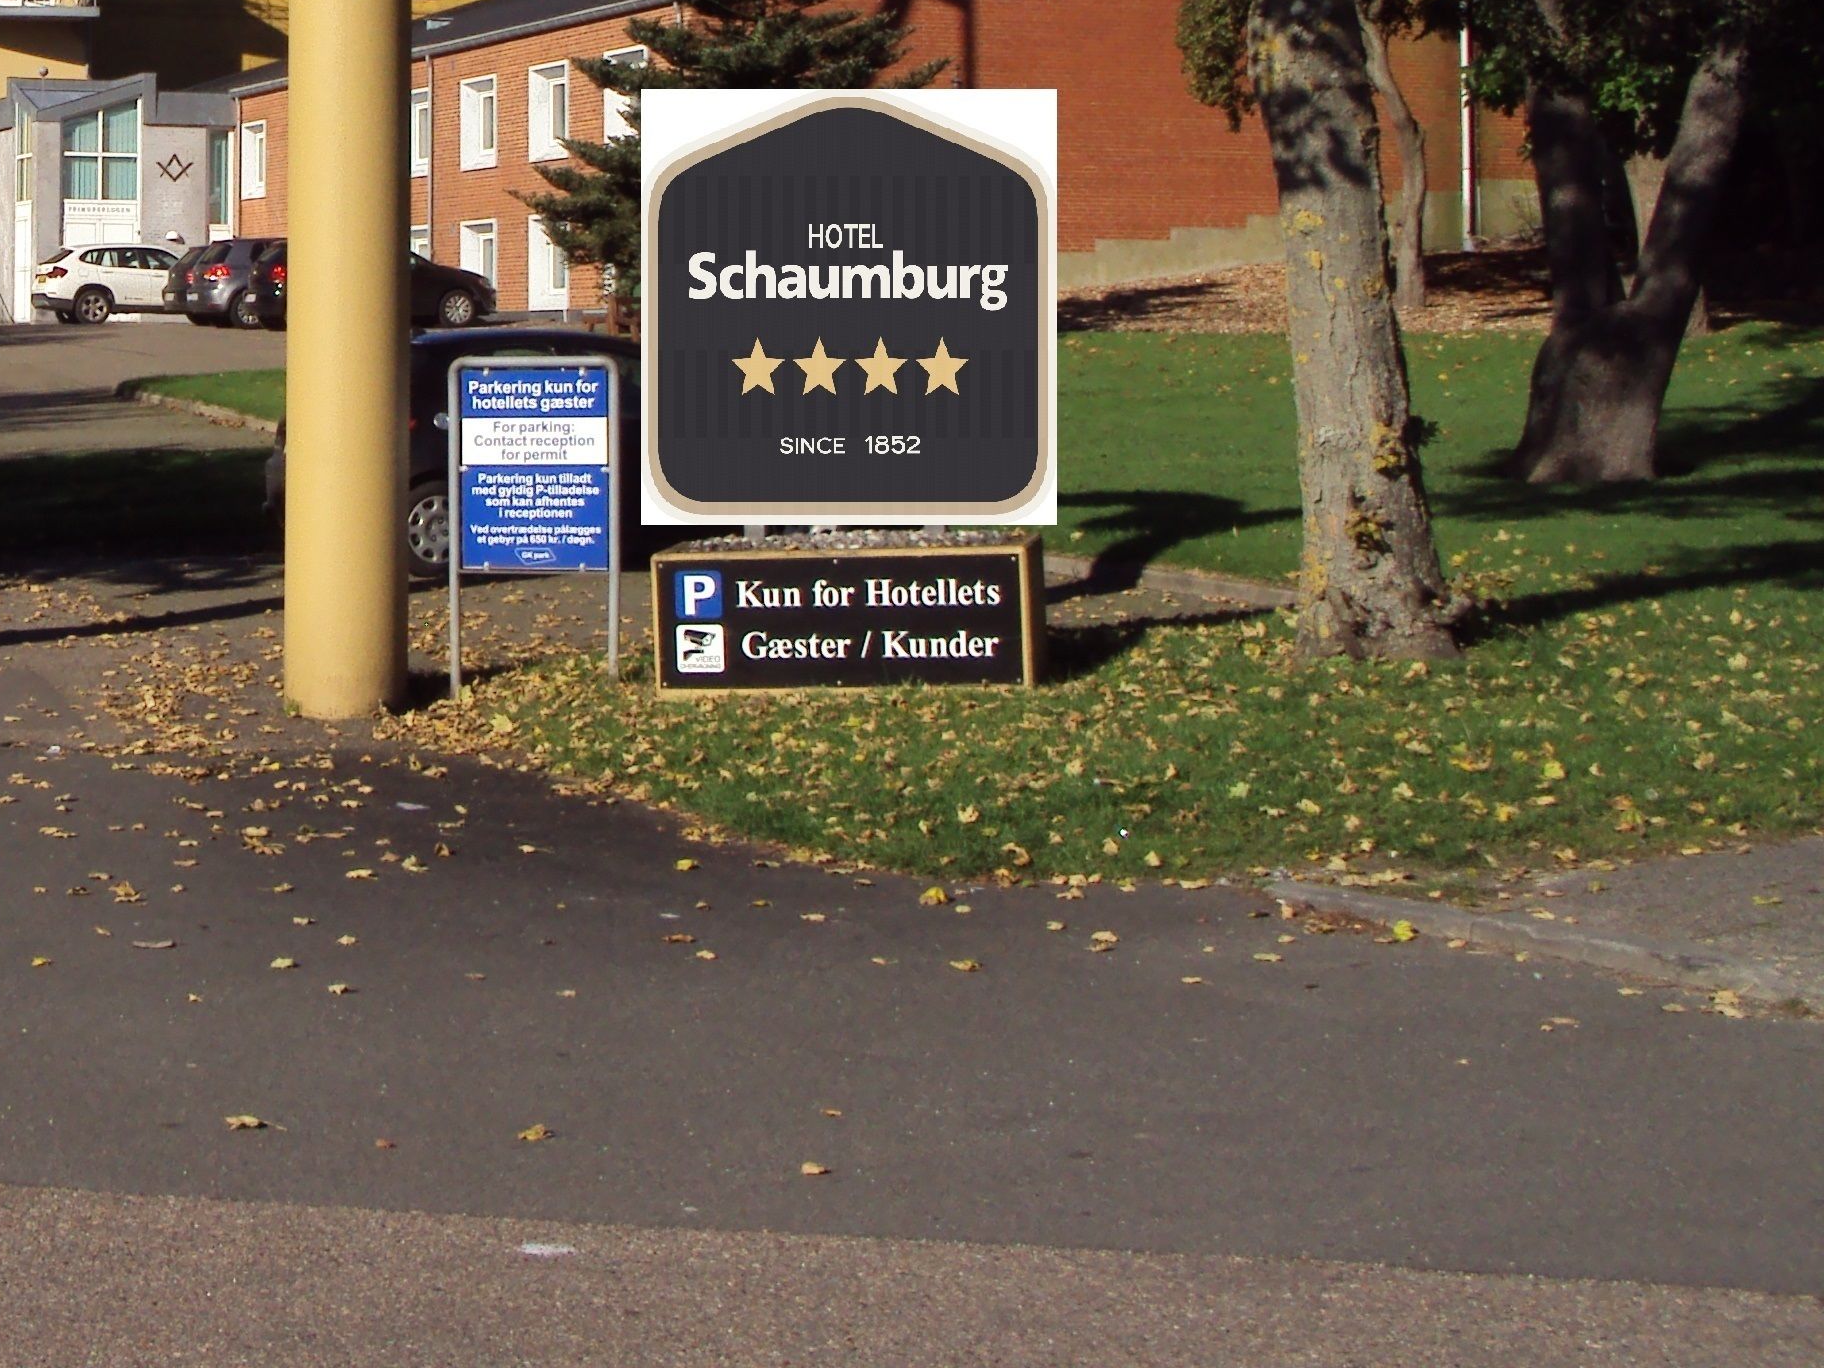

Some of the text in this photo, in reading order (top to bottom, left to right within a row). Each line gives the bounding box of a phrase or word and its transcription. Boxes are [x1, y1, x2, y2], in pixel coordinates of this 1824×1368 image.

[468, 379, 598, 396] Parkering kun for
[472, 396, 595, 412] hotellets gæster
[493, 421, 575, 436] For parking:
[474, 435, 595, 450] Contact reception
[501, 448, 568, 462] for permit
[478, 473, 592, 486] Parkering kun tilladt
[471, 485, 497, 495] med
[498, 485, 534, 497] gyldig
[485, 496, 585, 507] som kan afhentes
[504, 507, 573, 520] receptionen
[683, 575, 716, 615] P
[737, 578, 1001, 608] Kun for Hotellets
[741, 631, 852, 659] Gæster
[882, 630, 1000, 658] Kunder
